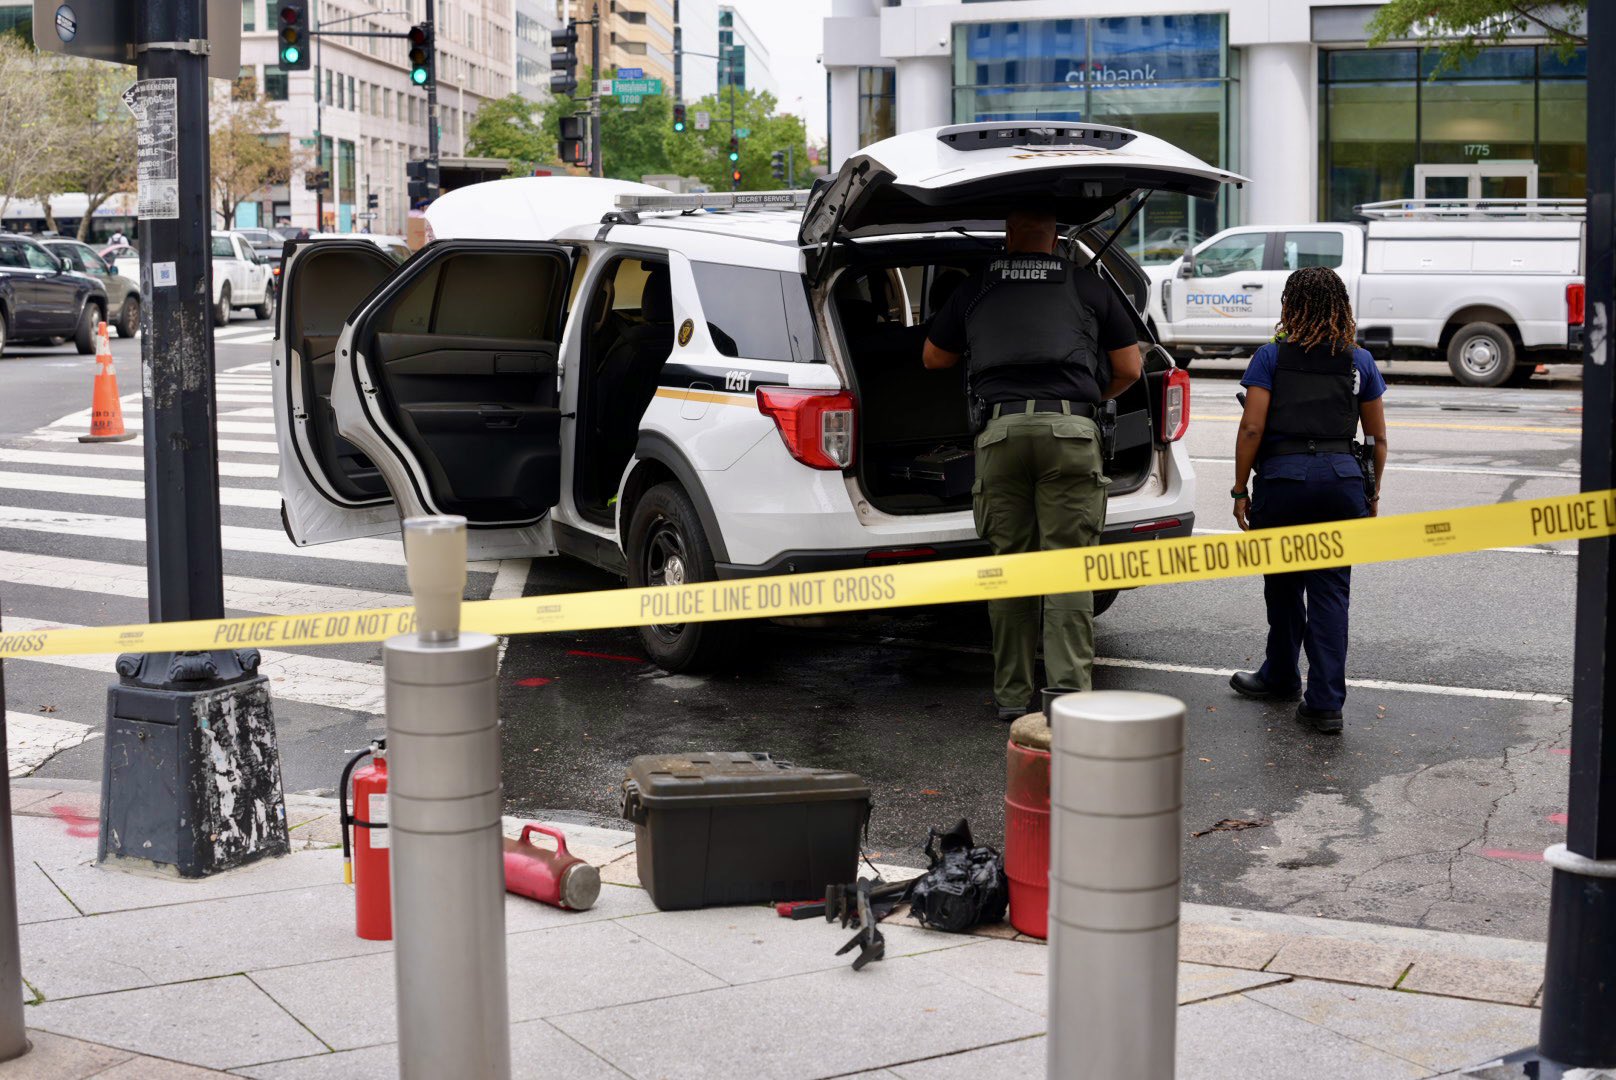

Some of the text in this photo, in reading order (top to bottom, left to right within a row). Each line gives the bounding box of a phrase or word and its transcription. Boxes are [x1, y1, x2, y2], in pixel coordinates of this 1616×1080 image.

[1464, 144, 1490, 156] 1775
[737, 195, 761, 203] SECRET
[1011, 260, 1062, 270] MARSHAL
[1001, 269, 1048, 280] POLICE
[1186, 294, 1252, 305] POTOMAC
[726, 370, 752, 391] 1251
[1530, 500, 1598, 536] POLICE
[1084, 530, 1344, 583] POLICE LINE DO NOT CROSS
[640, 573, 896, 618] POLICE LINE DO NOT CROSS
[214, 620, 278, 643] POLICE
[281, 617, 323, 640] LINE
[325, 616, 350, 638] DO
[355, 613, 392, 636] NOT
